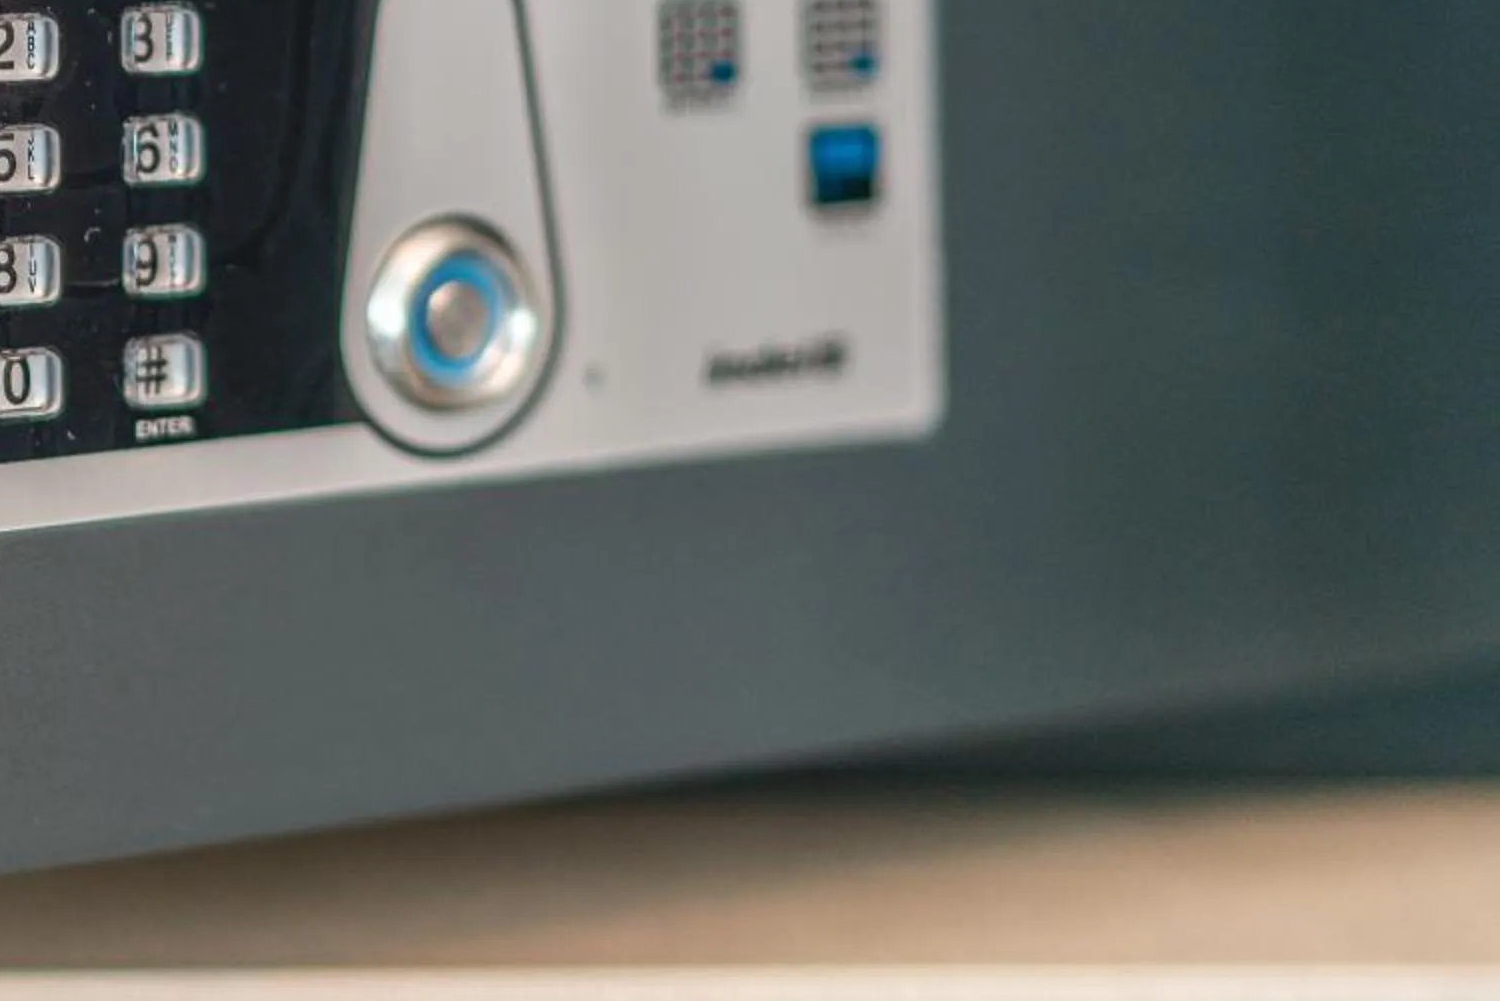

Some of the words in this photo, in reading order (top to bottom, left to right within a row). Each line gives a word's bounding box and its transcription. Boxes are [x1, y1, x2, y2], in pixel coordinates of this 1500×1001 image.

[134, 12, 153, 63] 3
[136, 124, 160, 174] 6
[135, 235, 157, 287] 9
[3, 354, 31, 405] 0
[134, 346, 168, 396] #
[135, 415, 194, 441] ENTER
